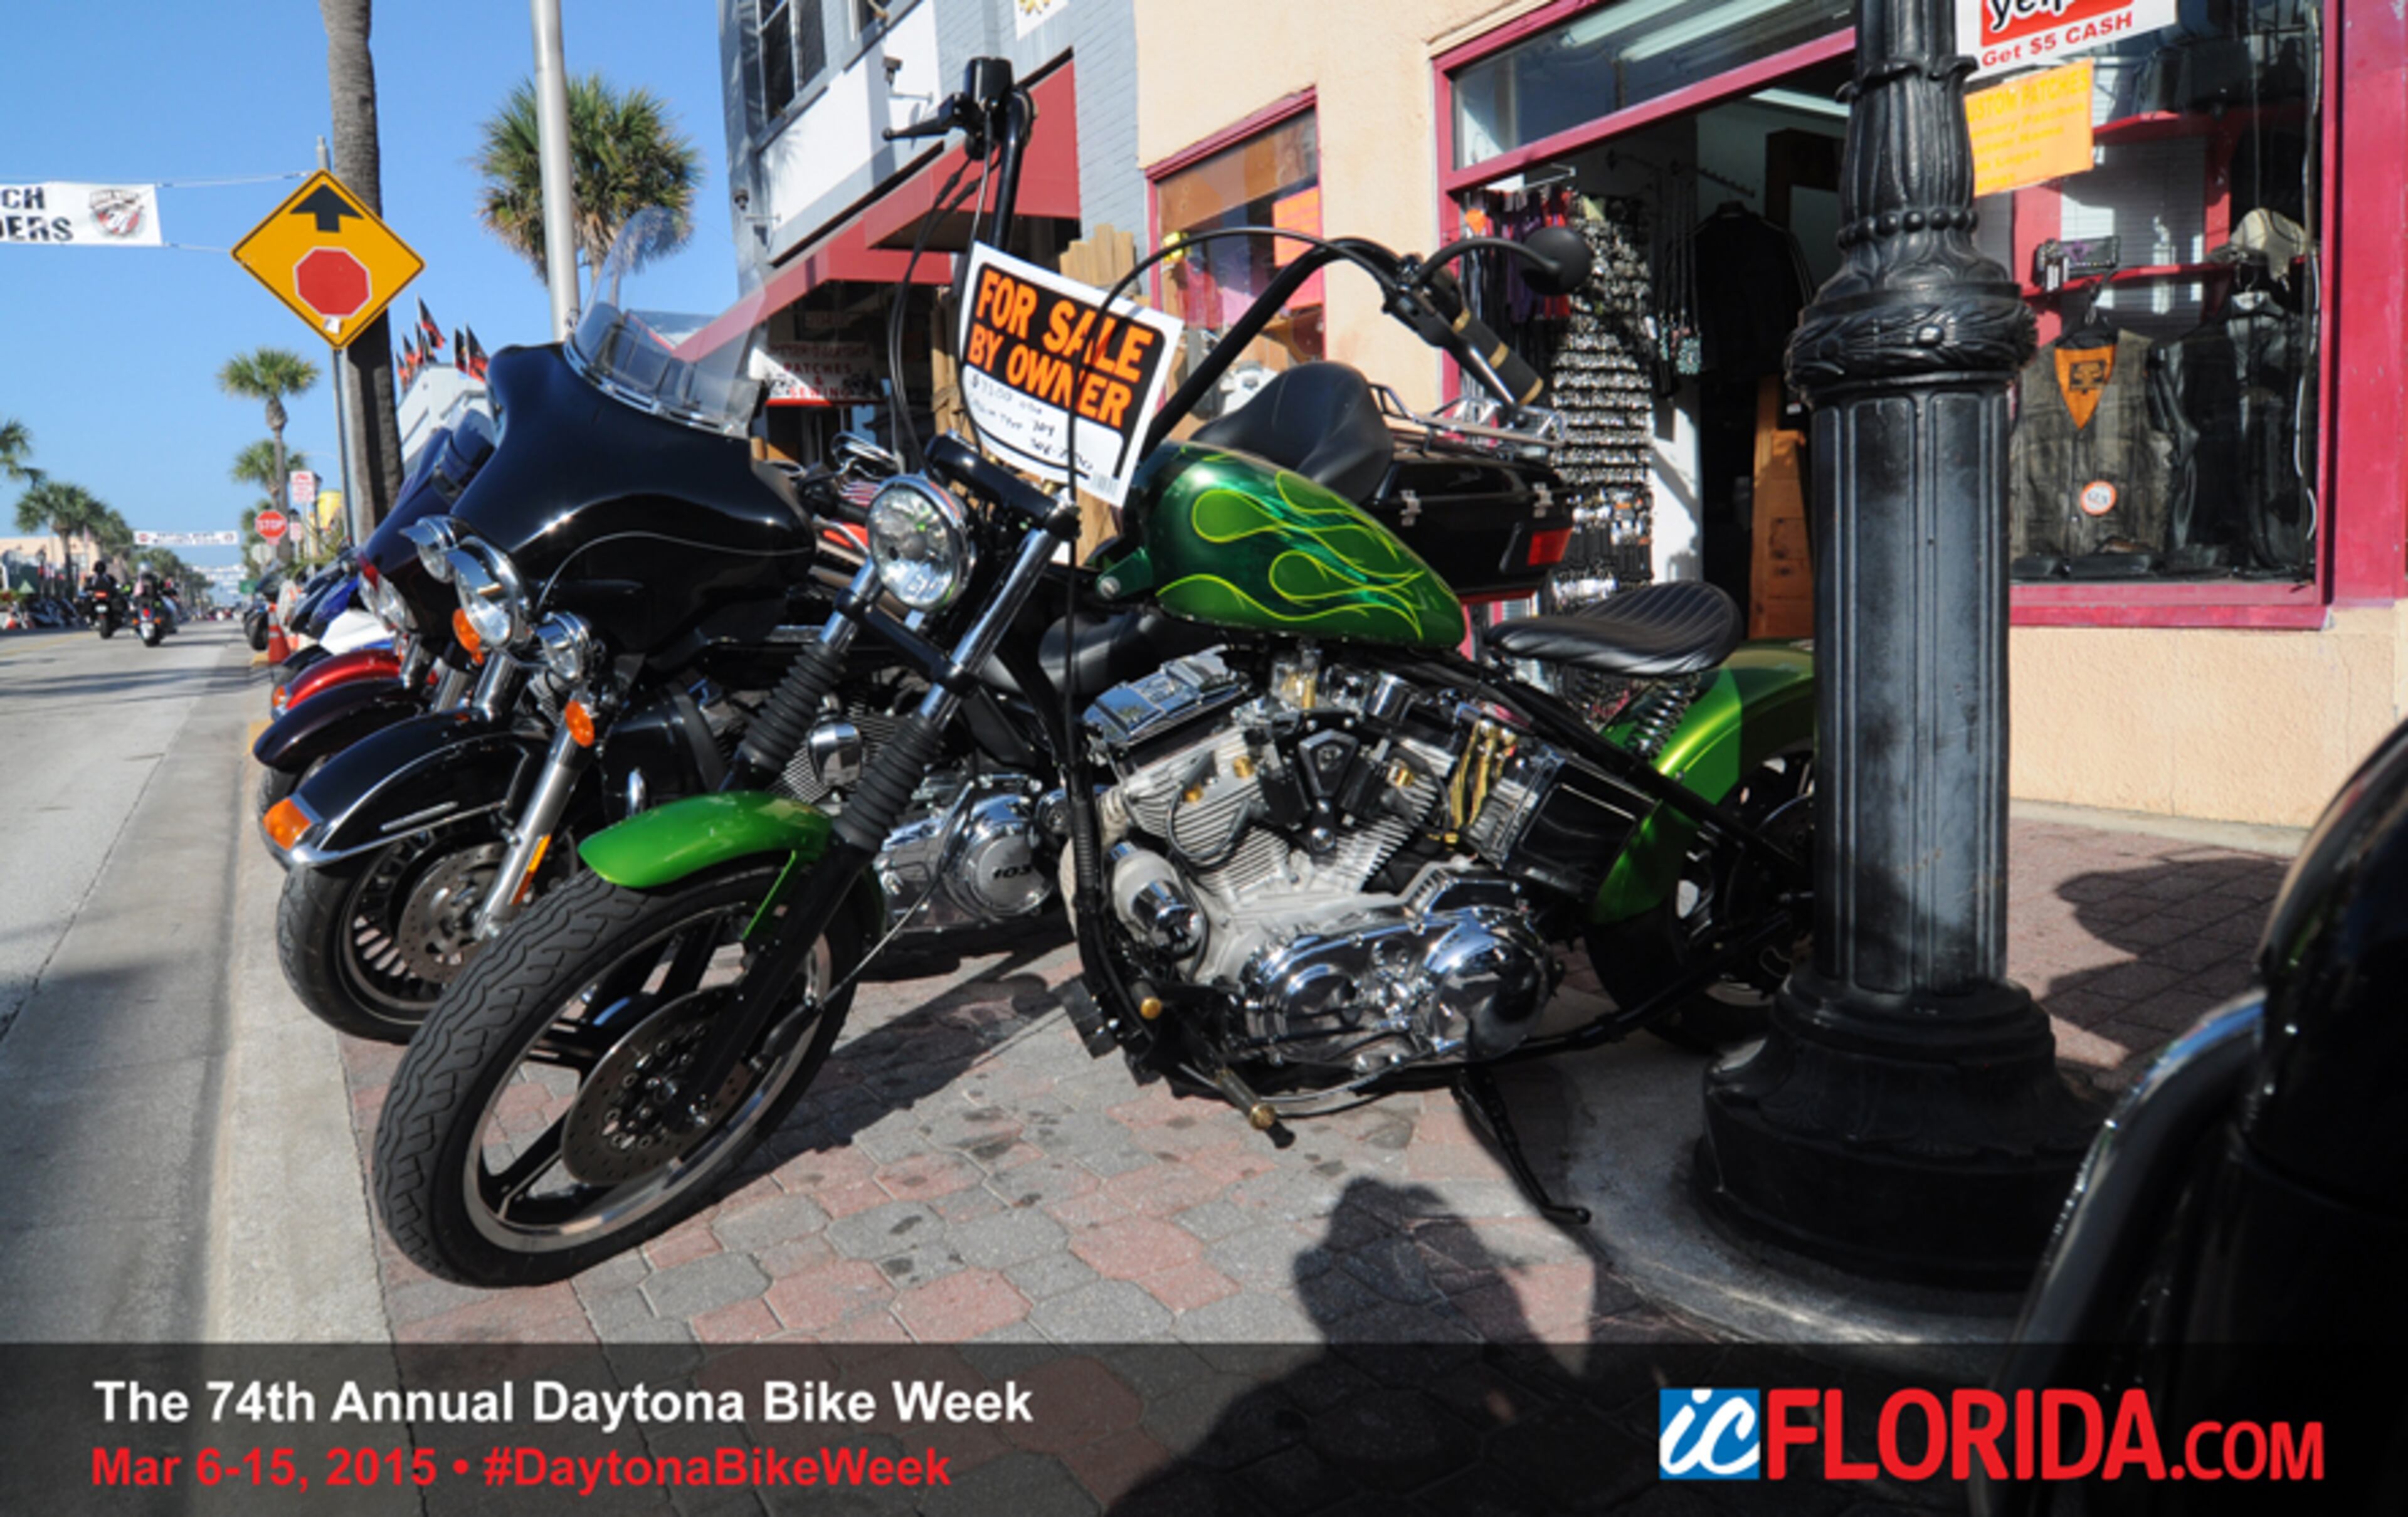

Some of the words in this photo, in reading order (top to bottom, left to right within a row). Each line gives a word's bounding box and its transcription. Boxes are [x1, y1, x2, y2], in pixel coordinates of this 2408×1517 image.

[1982, 45, 2021, 66] Get
[2030, 33, 2057, 55] $5
[2066, 12, 2133, 43] CASH
[1967, 88, 2016, 122] USTOM
[2022, 68, 2088, 105] PATCHES
[2, 187, 45, 209] CH
[0, 216, 74, 241] ERS
[976, 269, 1038, 339] FOR
[1042, 300, 1154, 383] SALE
[784, 362, 852, 374] PATCHES
[968, 322, 1004, 372] BY
[1006, 344, 1132, 428] OWNER
[256, 519, 287, 531] STOP
